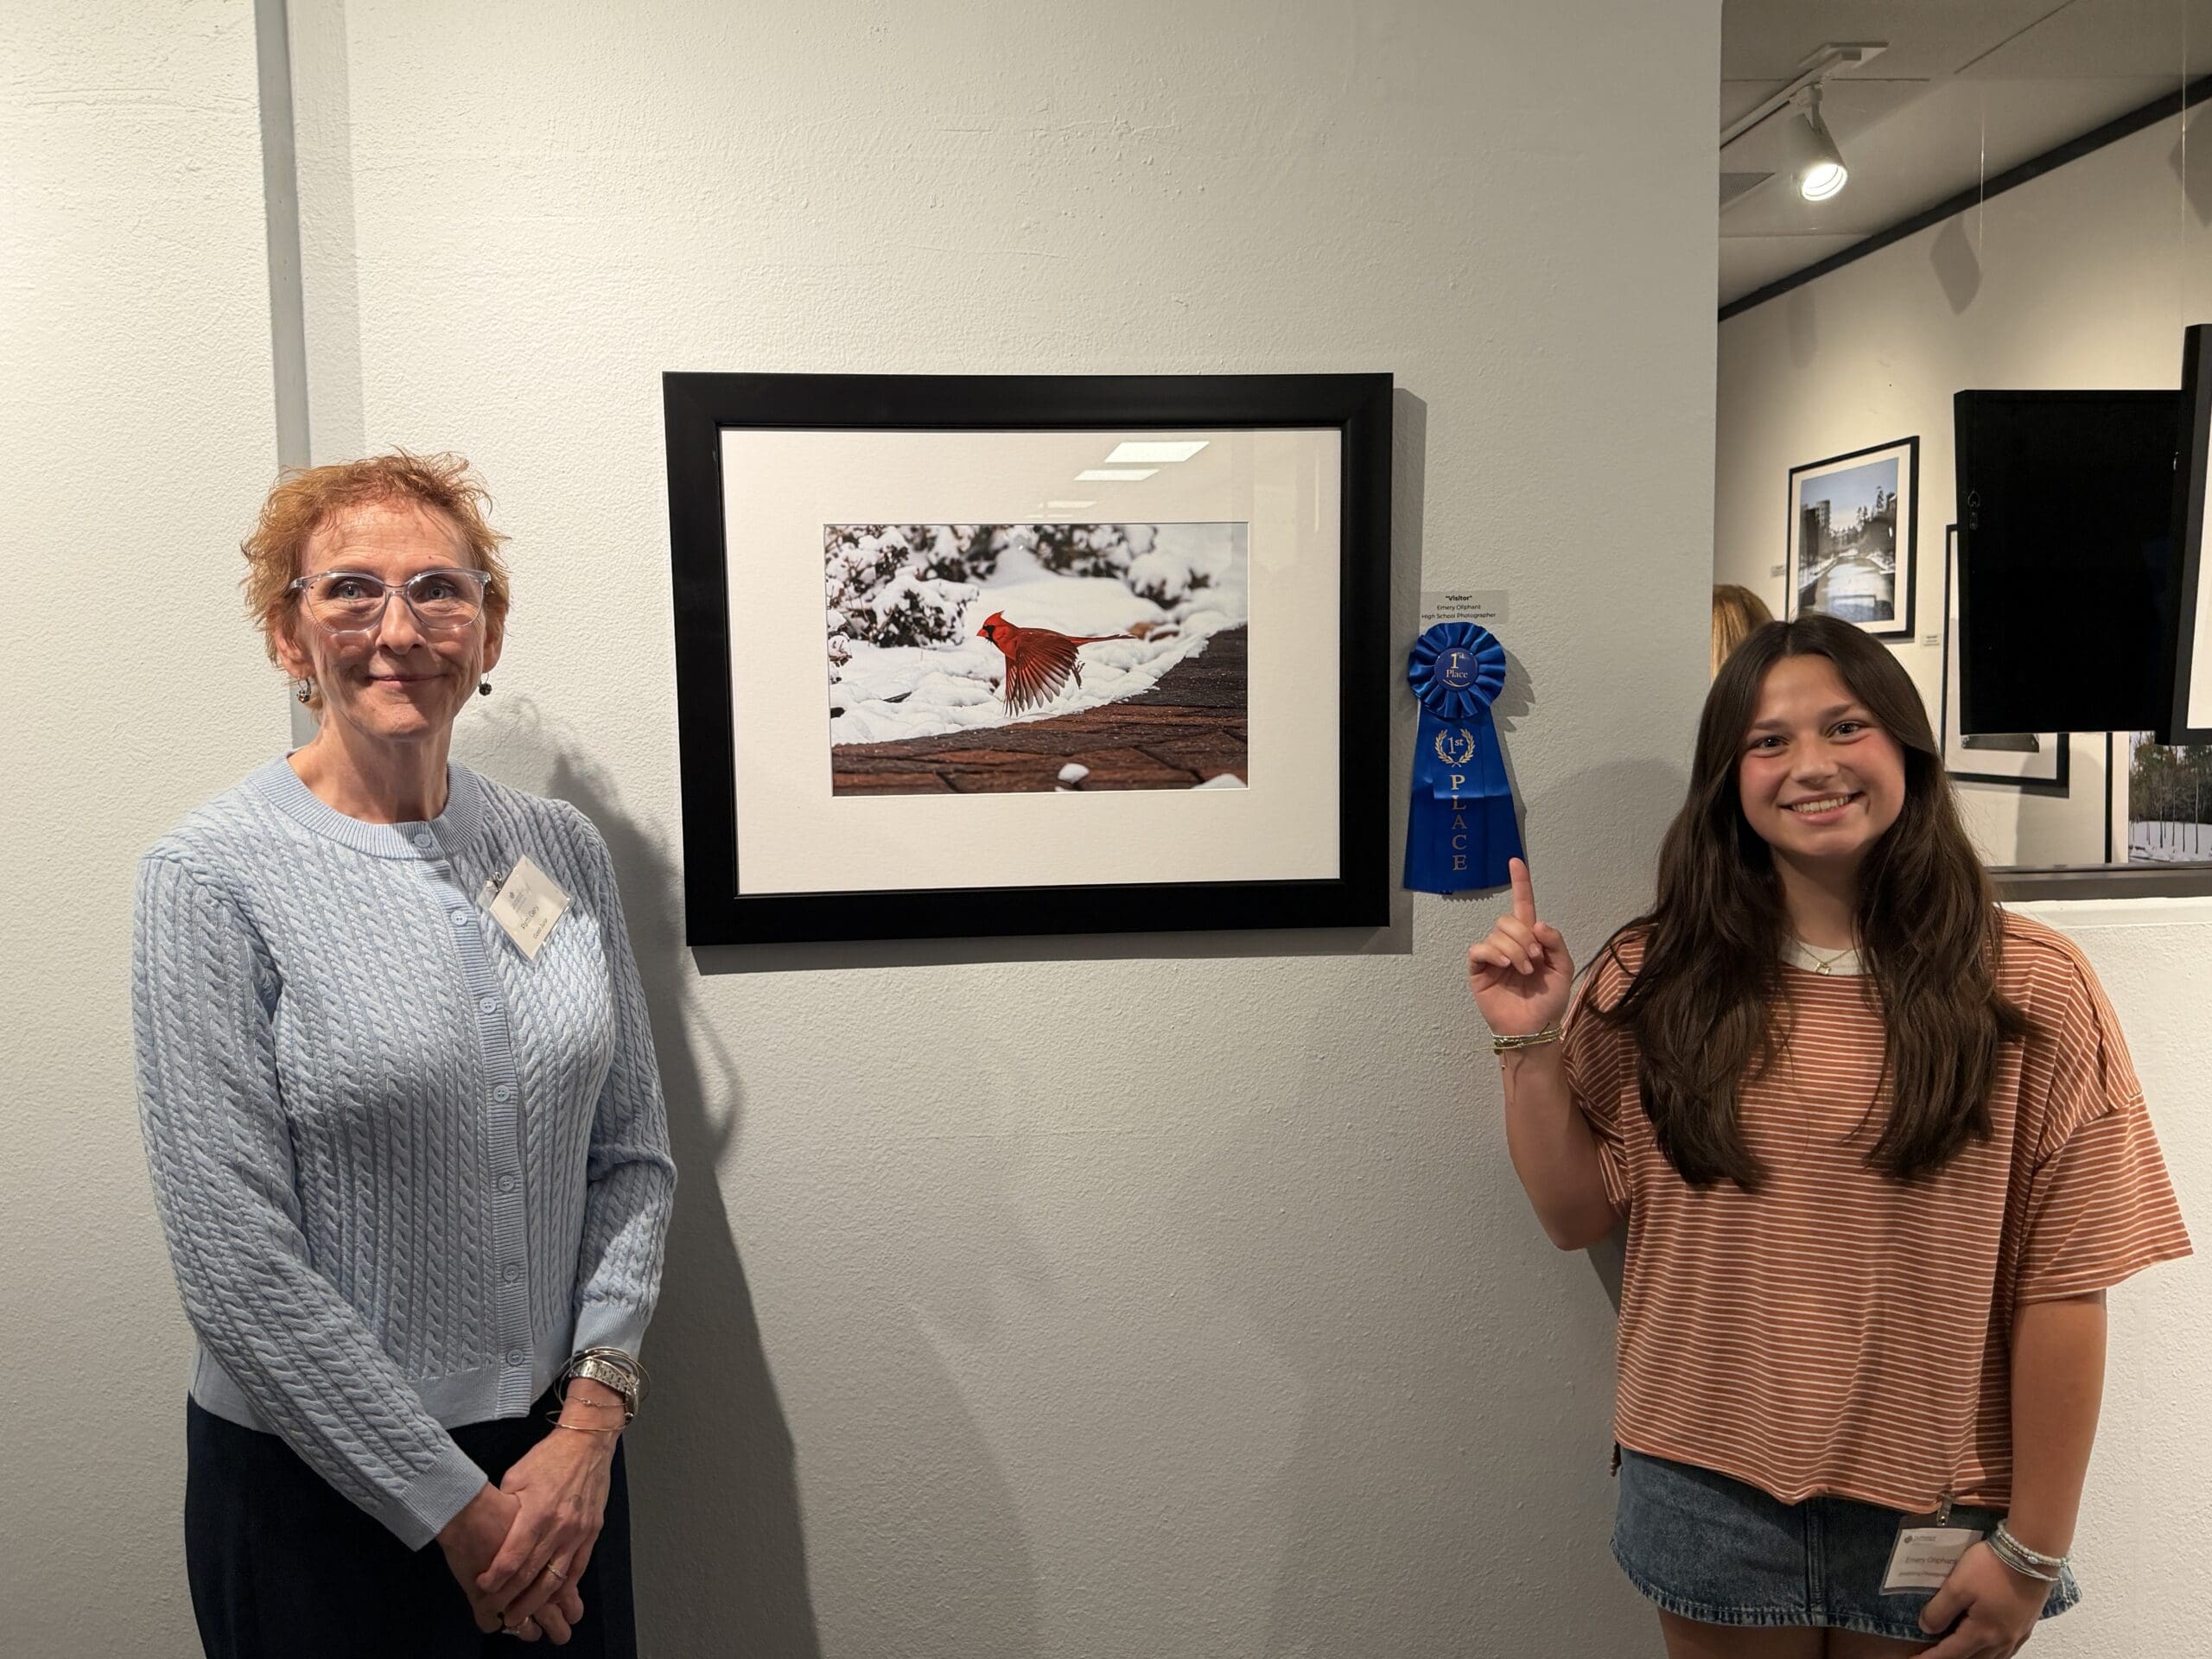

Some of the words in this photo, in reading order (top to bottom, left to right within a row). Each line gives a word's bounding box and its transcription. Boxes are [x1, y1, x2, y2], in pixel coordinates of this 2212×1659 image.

[1446, 669, 1468, 678] Place
[1447, 736, 1464, 754] 1st
[1450, 774, 1467, 871] PLACE
